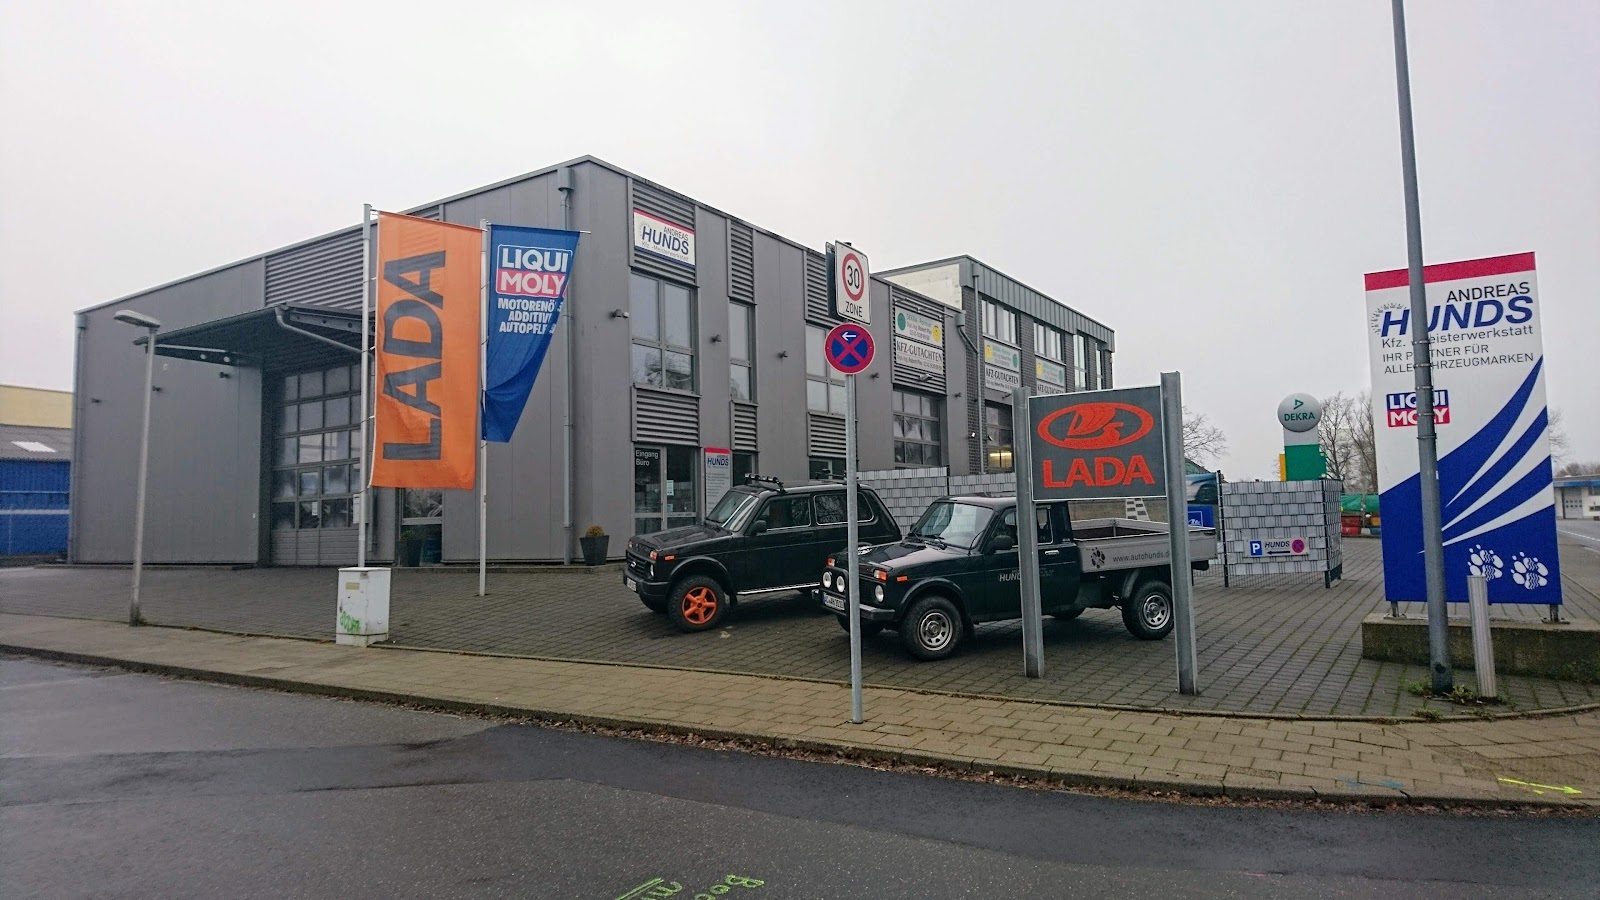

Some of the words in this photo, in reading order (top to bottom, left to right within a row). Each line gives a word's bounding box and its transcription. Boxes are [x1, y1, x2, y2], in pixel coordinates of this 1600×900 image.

[641, 226, 689, 255] HUNDS
[502, 248, 569, 272] LIQUI
[500, 271, 566, 295] MOLY
[846, 265, 861, 289] 30
[1446, 281, 1531, 303] ANDREAS
[845, 301, 863, 317] ZONE
[1382, 338, 1406, 348] Kfz.
[1383, 352, 1403, 363] IHR
[1406, 346, 1461, 361] PTNER
[1464, 343, 1490, 355] FÜR
[383, 250, 446, 460] LADA
[1284, 412, 1316, 421] DEKRA
[1390, 408, 1448, 426] MOY
[635, 450, 659, 460] Eingang
[707, 457, 729, 467] HUNDS
[1042, 454, 1156, 488] LADA
[1112, 551, 1170, 562] www.autohunds.d
